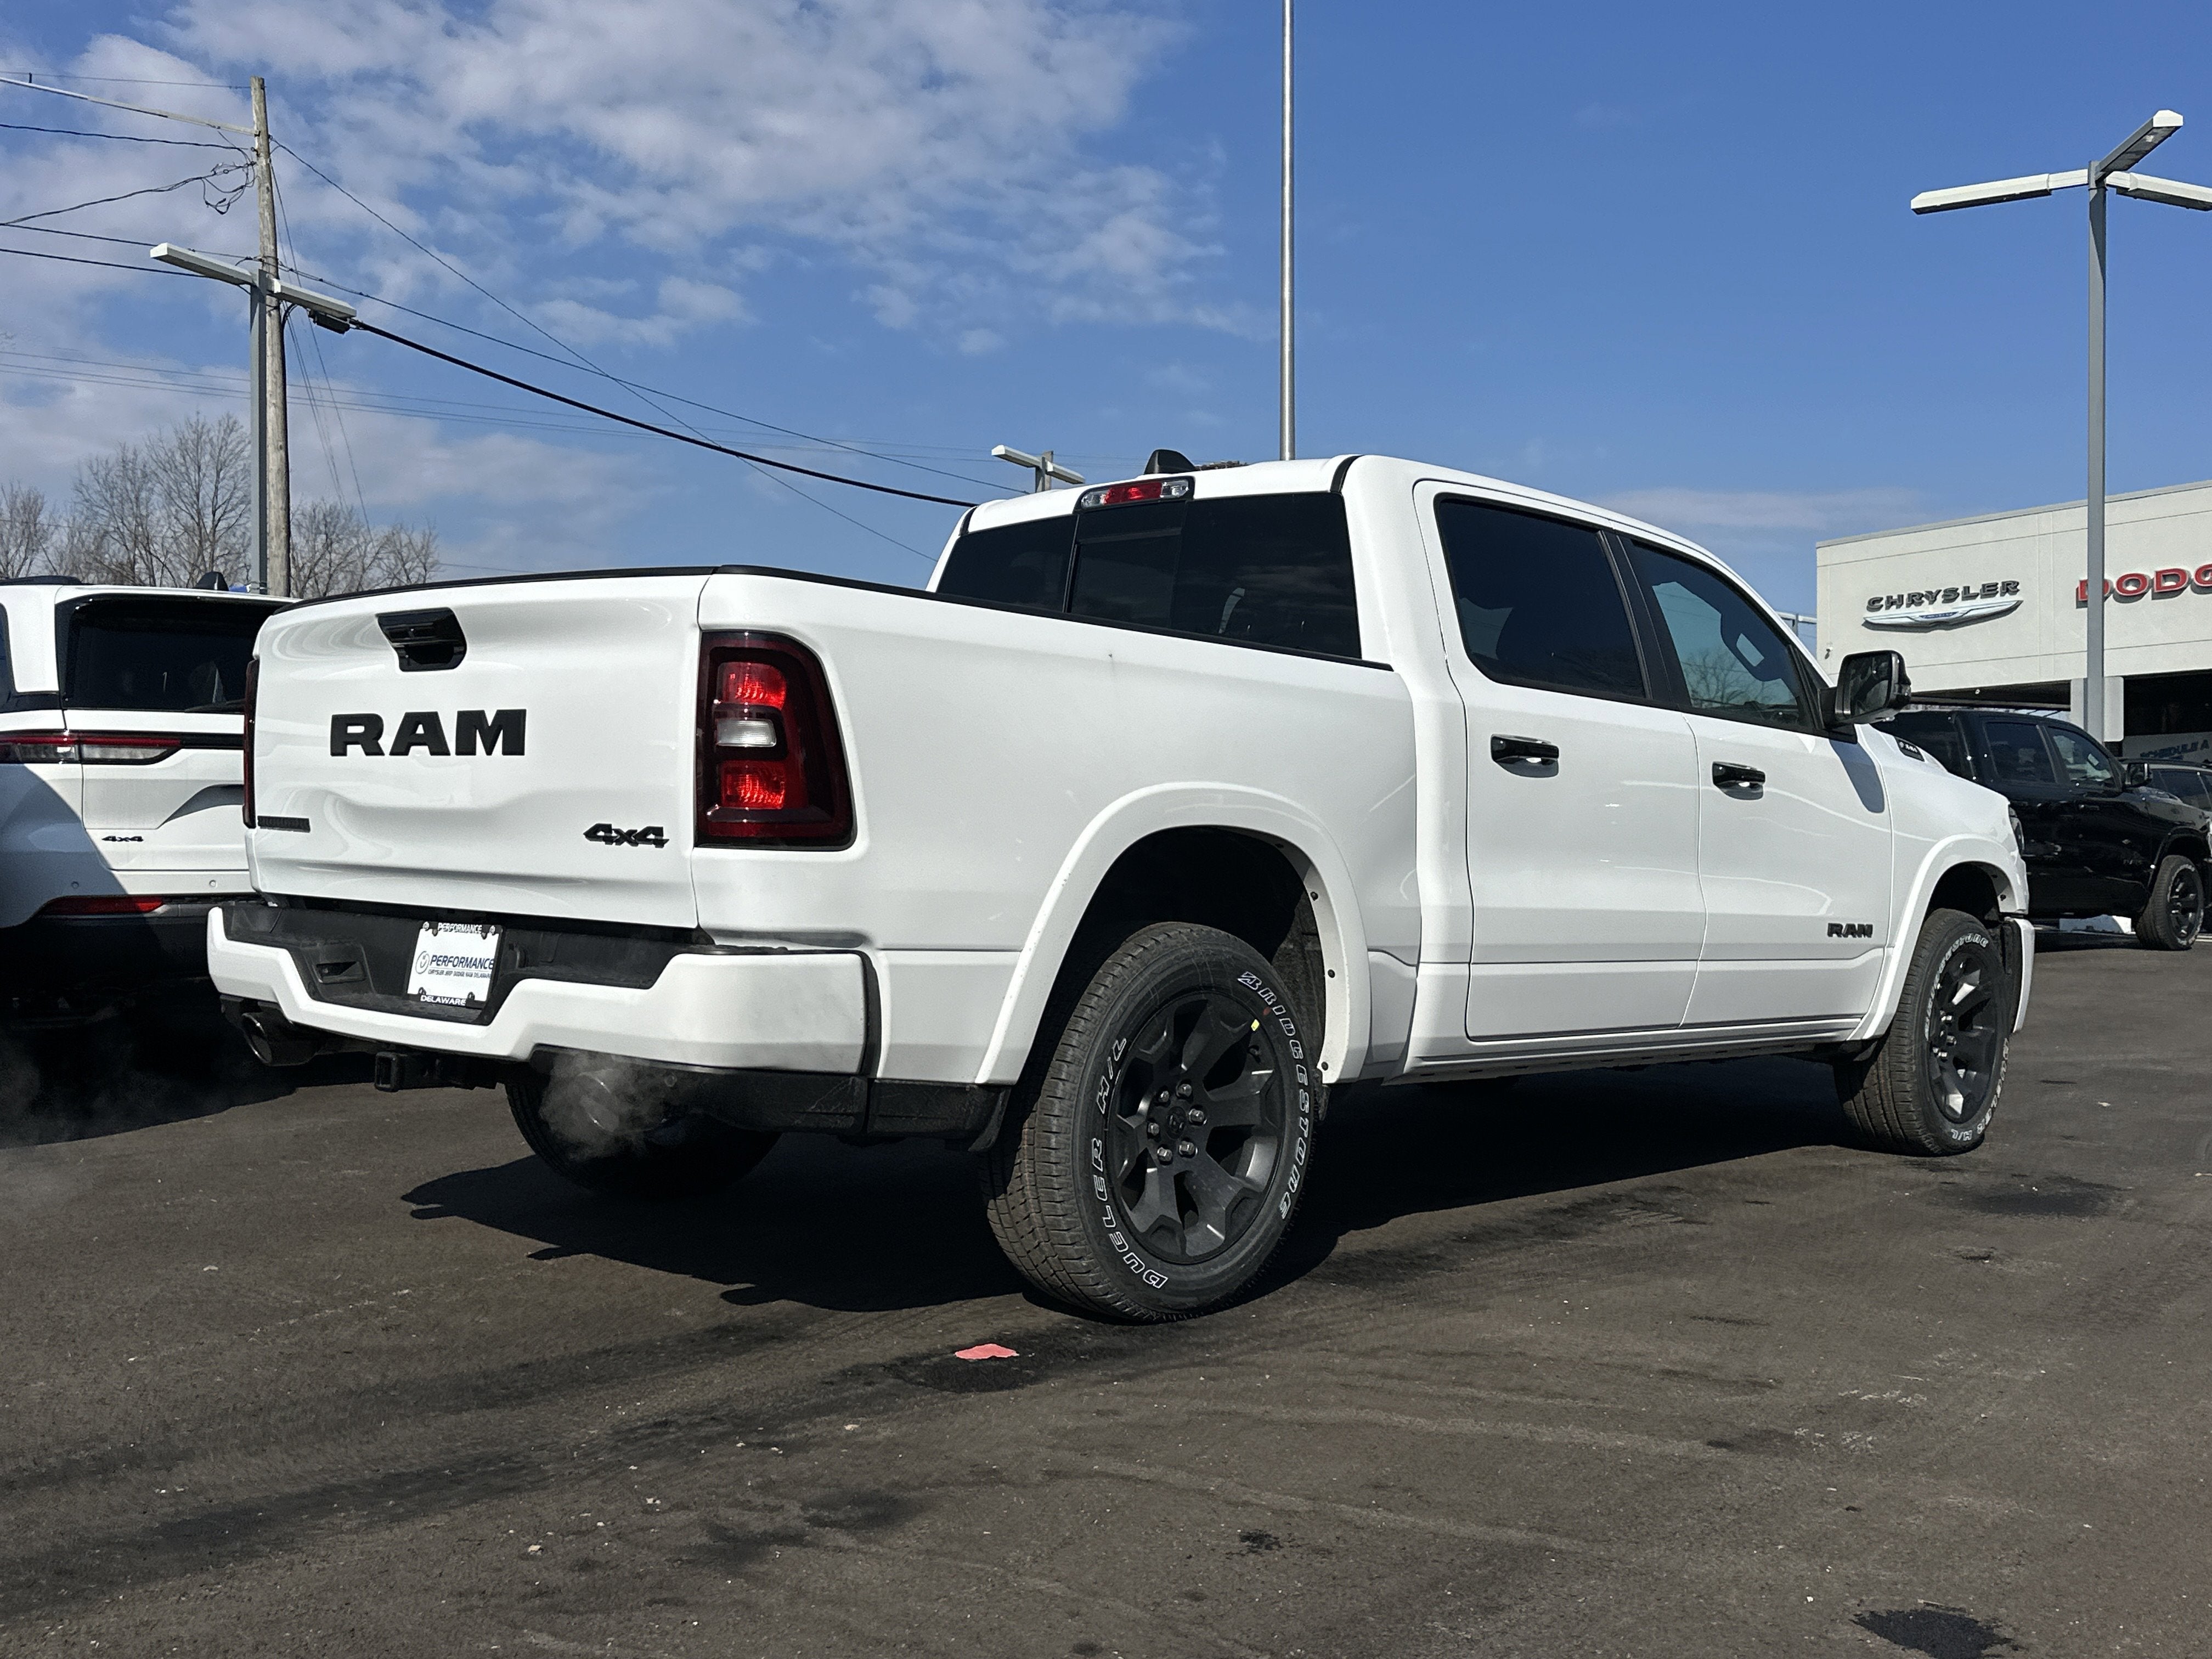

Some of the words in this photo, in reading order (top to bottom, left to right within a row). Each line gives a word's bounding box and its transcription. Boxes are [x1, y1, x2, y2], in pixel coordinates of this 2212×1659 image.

[1866, 580, 2021, 612] CHRYSLER
[330, 709, 527, 757] RAM
[583, 823, 670, 848] 4x4
[438, 922, 482, 934] PERFORMANCE
[1827, 923, 1873, 938] RAM
[430, 955, 494, 969] PERFORMANCE
[420, 995, 466, 1006] DELAWARE
[1238, 971, 1309, 1220] BRIDGESTONE
[1092, 1138, 1169, 1289] DUELER
